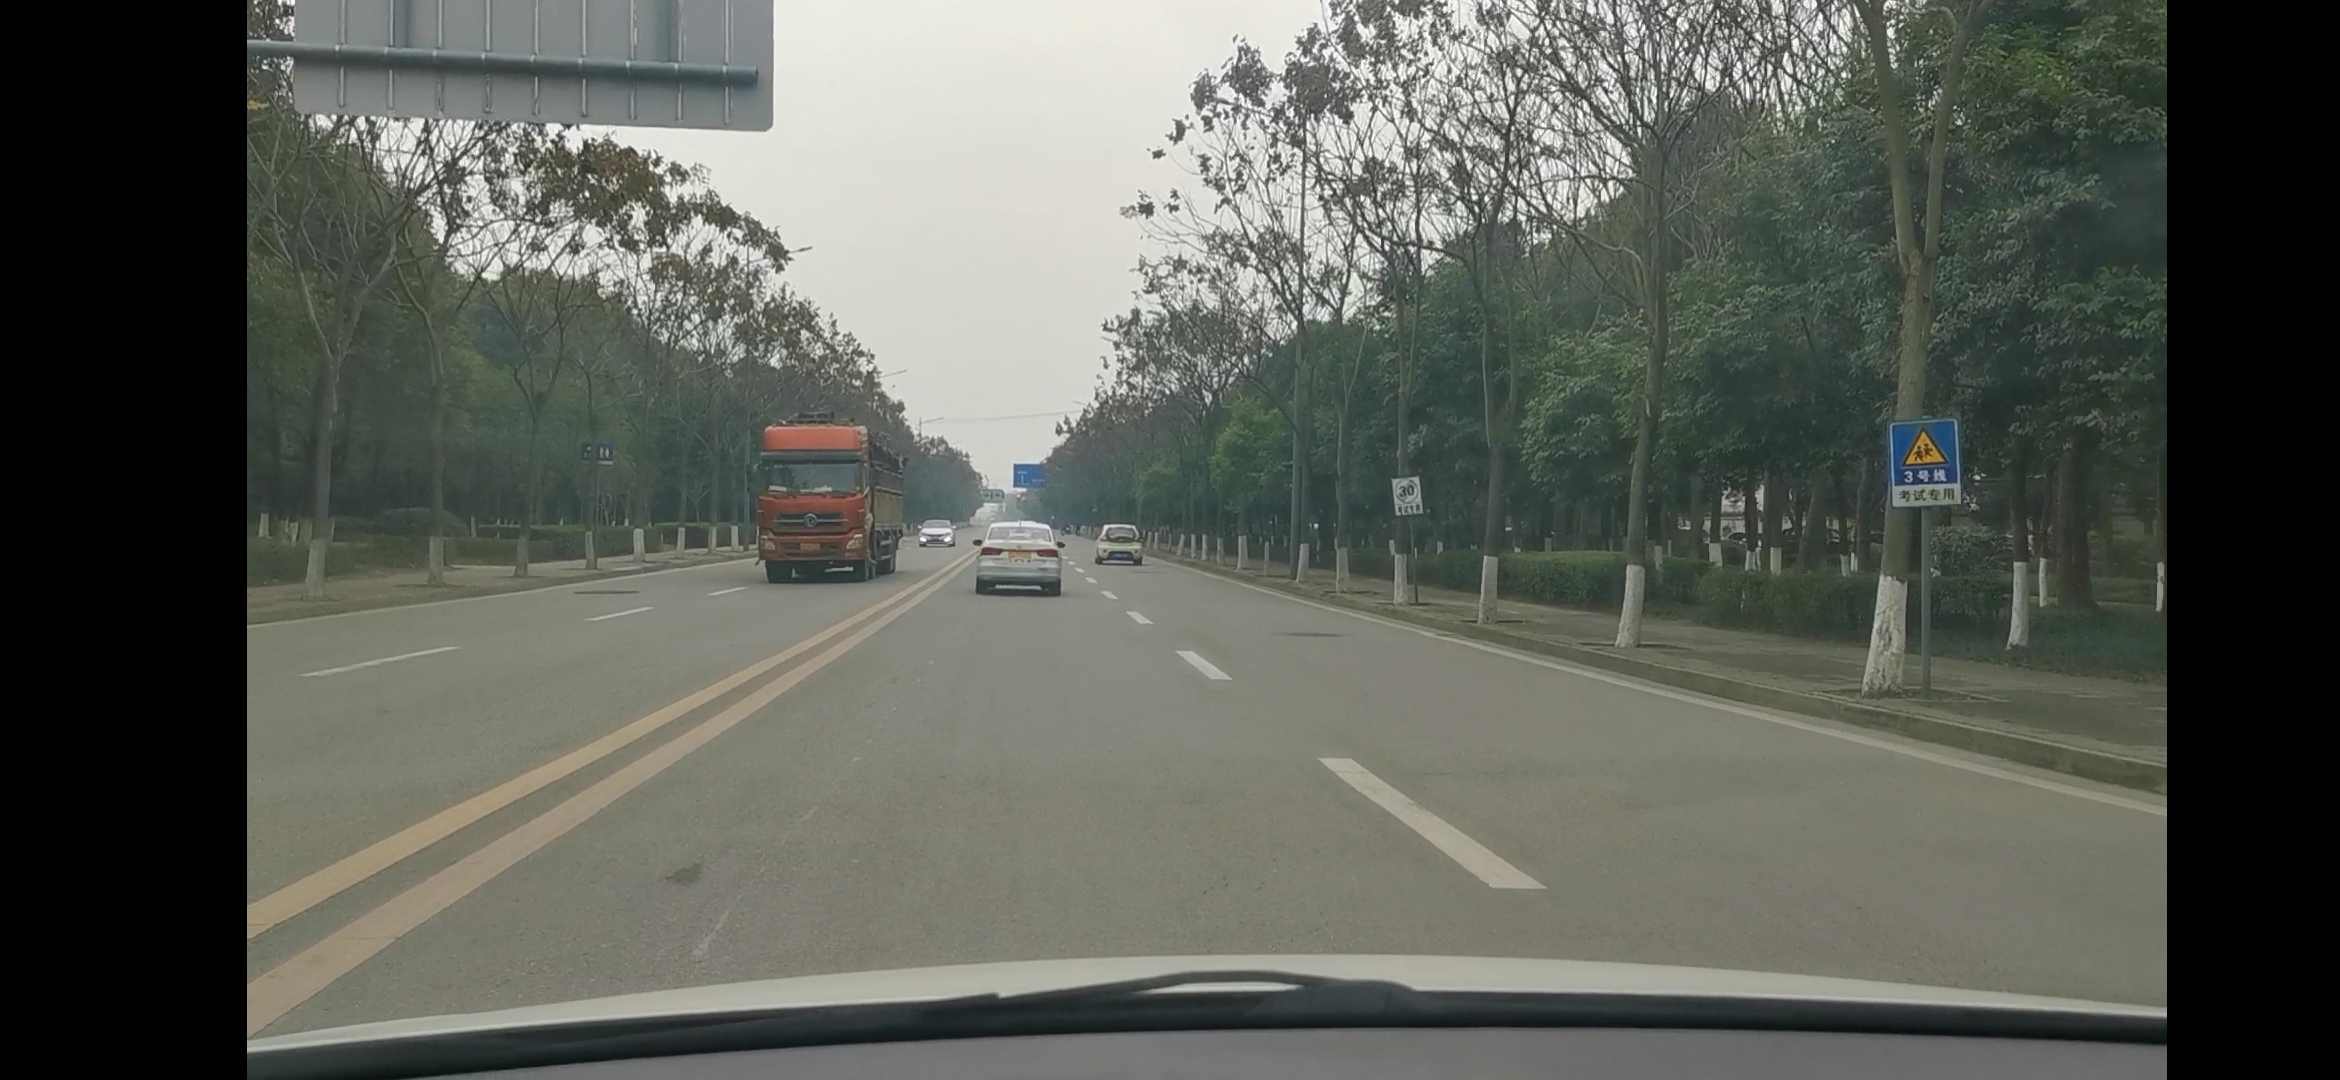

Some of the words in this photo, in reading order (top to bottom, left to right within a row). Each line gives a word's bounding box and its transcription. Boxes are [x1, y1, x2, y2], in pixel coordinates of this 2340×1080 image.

[1904, 469, 1947, 483] 3号线
[1398, 485, 1415, 497] 30
[1898, 488, 1955, 502] 考试专用
